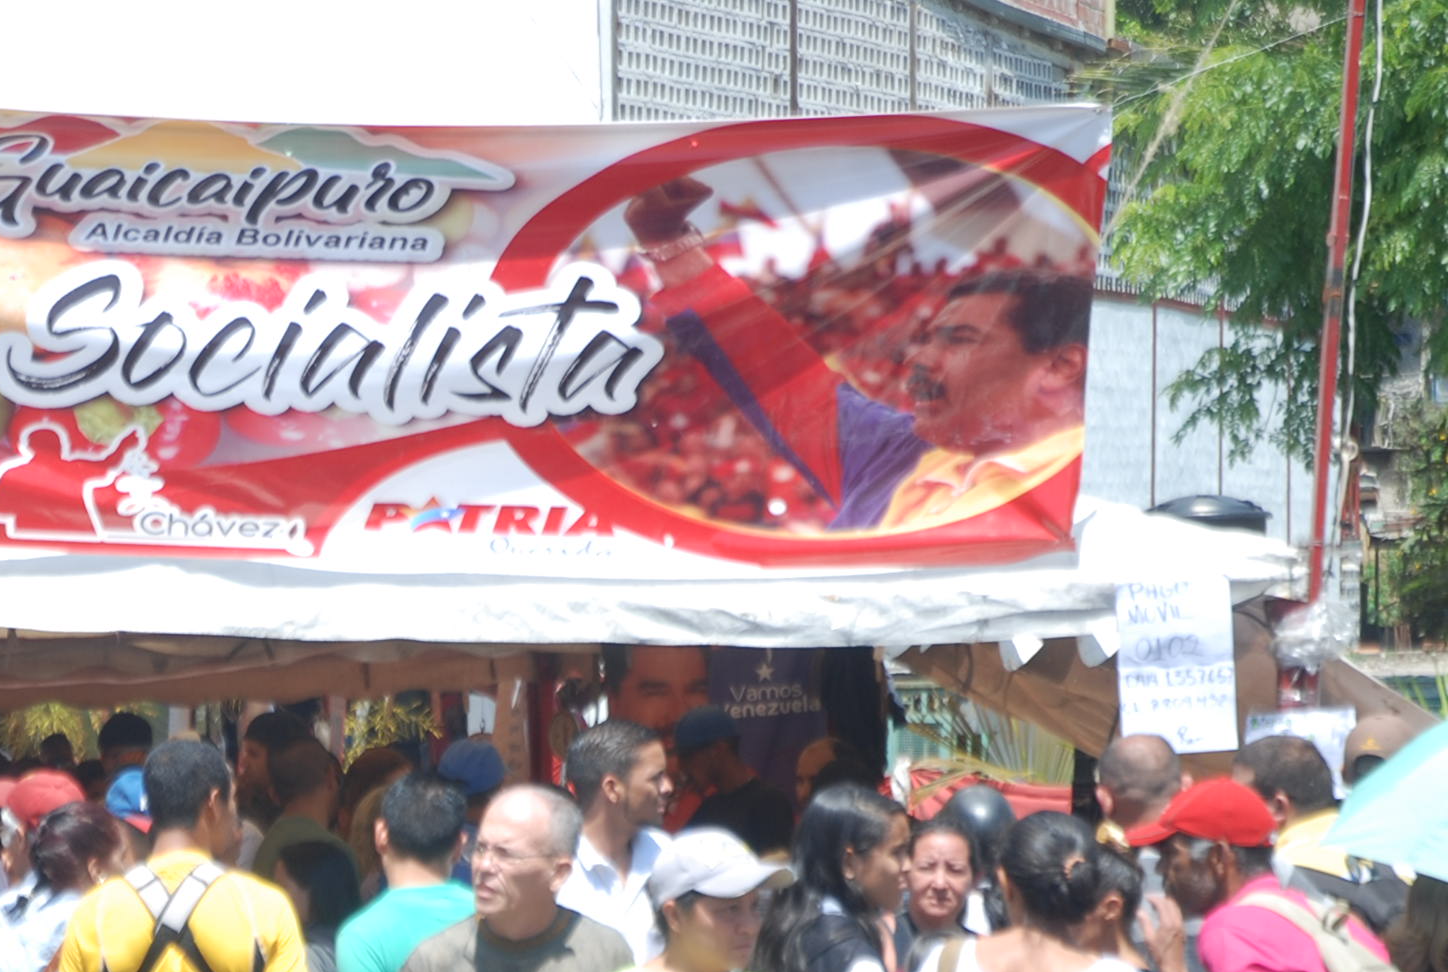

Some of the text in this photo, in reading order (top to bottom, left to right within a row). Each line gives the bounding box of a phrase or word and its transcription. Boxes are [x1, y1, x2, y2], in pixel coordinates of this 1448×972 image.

[86, 222, 430, 253] Alcaldía Bolivariana
[7, 275, 643, 414] Socialista
[140, 511, 280, 538] Chávez
[729, 684, 803, 703] Vamos
